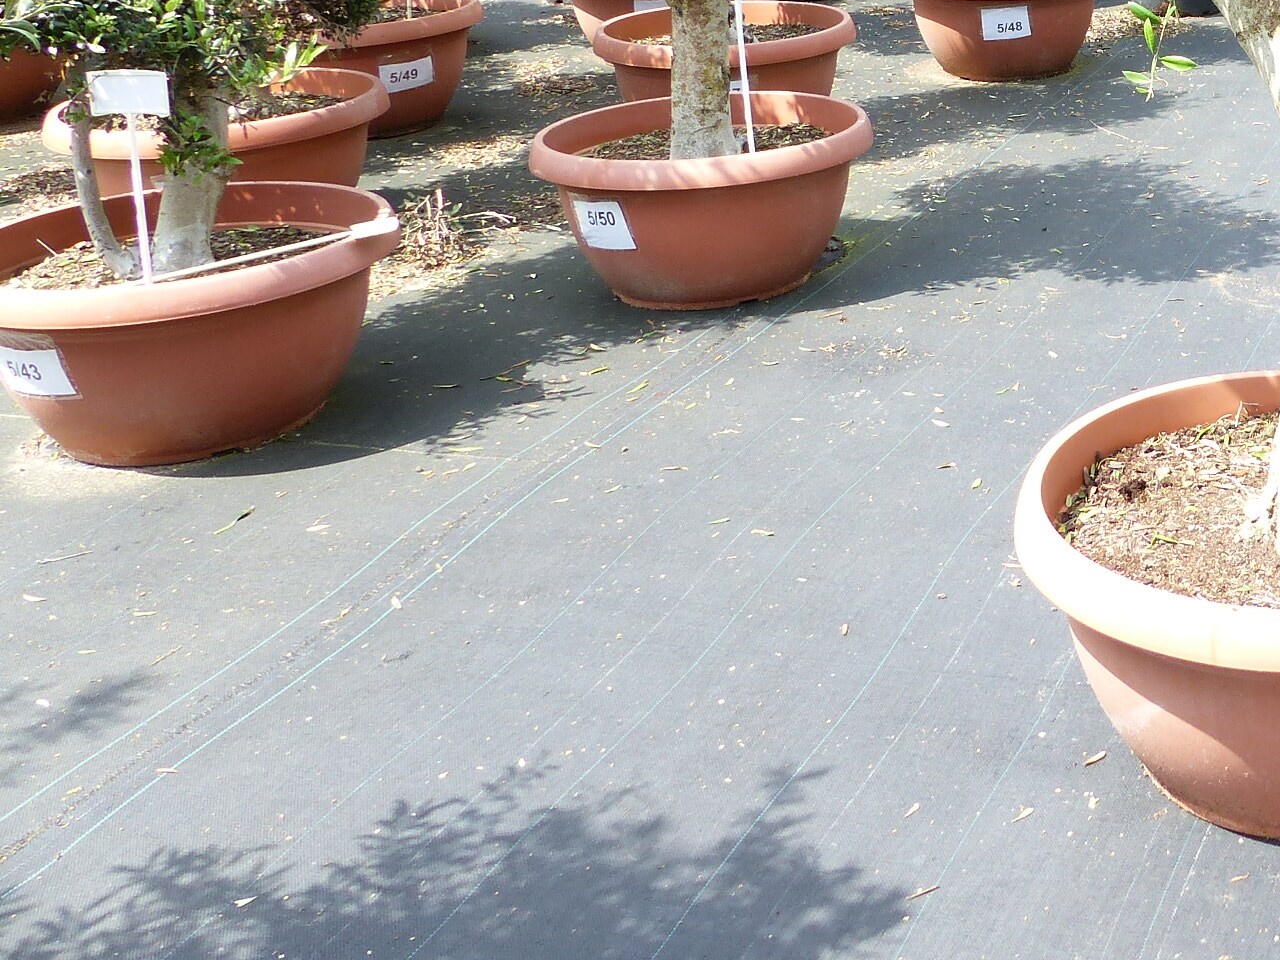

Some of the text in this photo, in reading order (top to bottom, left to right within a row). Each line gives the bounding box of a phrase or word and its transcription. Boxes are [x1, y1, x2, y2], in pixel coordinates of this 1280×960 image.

[997, 21, 1023, 33] 5/48
[390, 68, 418, 83] 5/49
[587, 210, 616, 226] 5/50
[7, 360, 42, 380] 5/43
